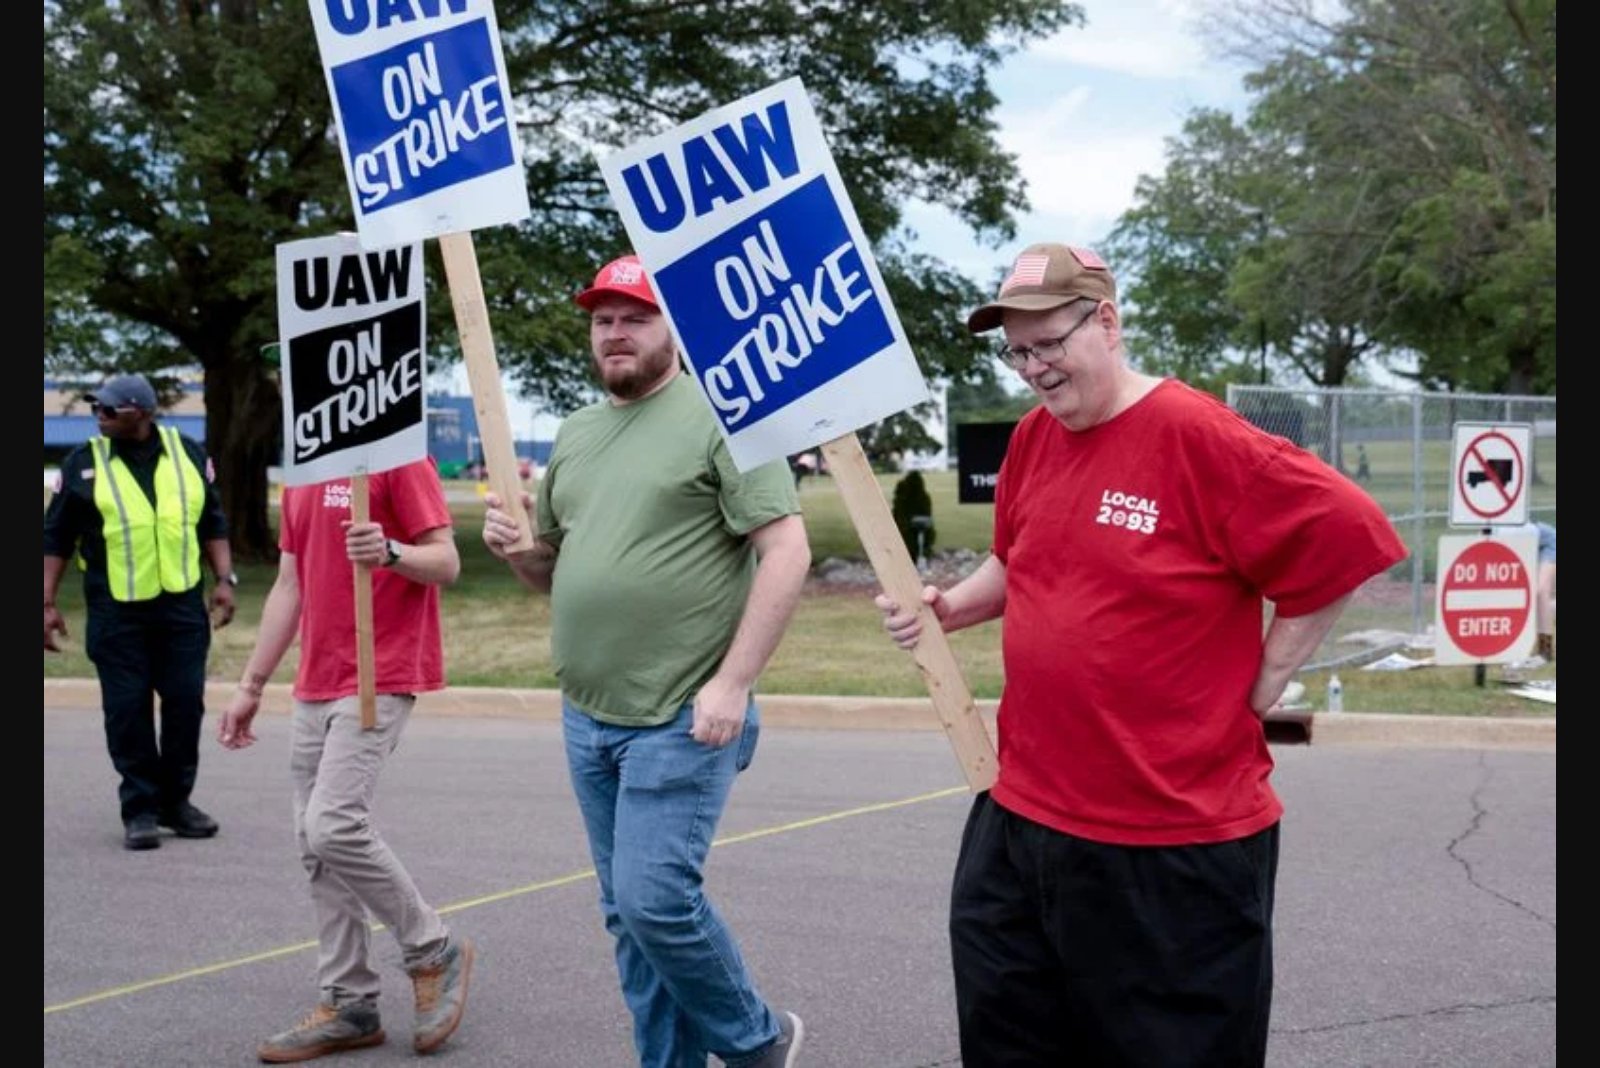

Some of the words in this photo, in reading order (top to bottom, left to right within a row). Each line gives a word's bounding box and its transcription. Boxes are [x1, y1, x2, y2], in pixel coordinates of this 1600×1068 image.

[325, 0, 467, 35] UA
[382, 42, 442, 121] ON
[354, 75, 506, 208] STRIKE
[622, 101, 800, 232] UAW
[293, 246, 413, 312] UAW
[714, 220, 791, 320] ON
[328, 321, 382, 387] ON
[704, 242, 872, 425] STRIKE
[295, 349, 421, 458] STRIKE
[1096, 505, 1158, 535] 2093
[1101, 489, 1159, 516] LOCAL
[1454, 563, 1476, 581] DO
[1485, 562, 1520, 581] NOT
[1458, 617, 1511, 637] ENTER
